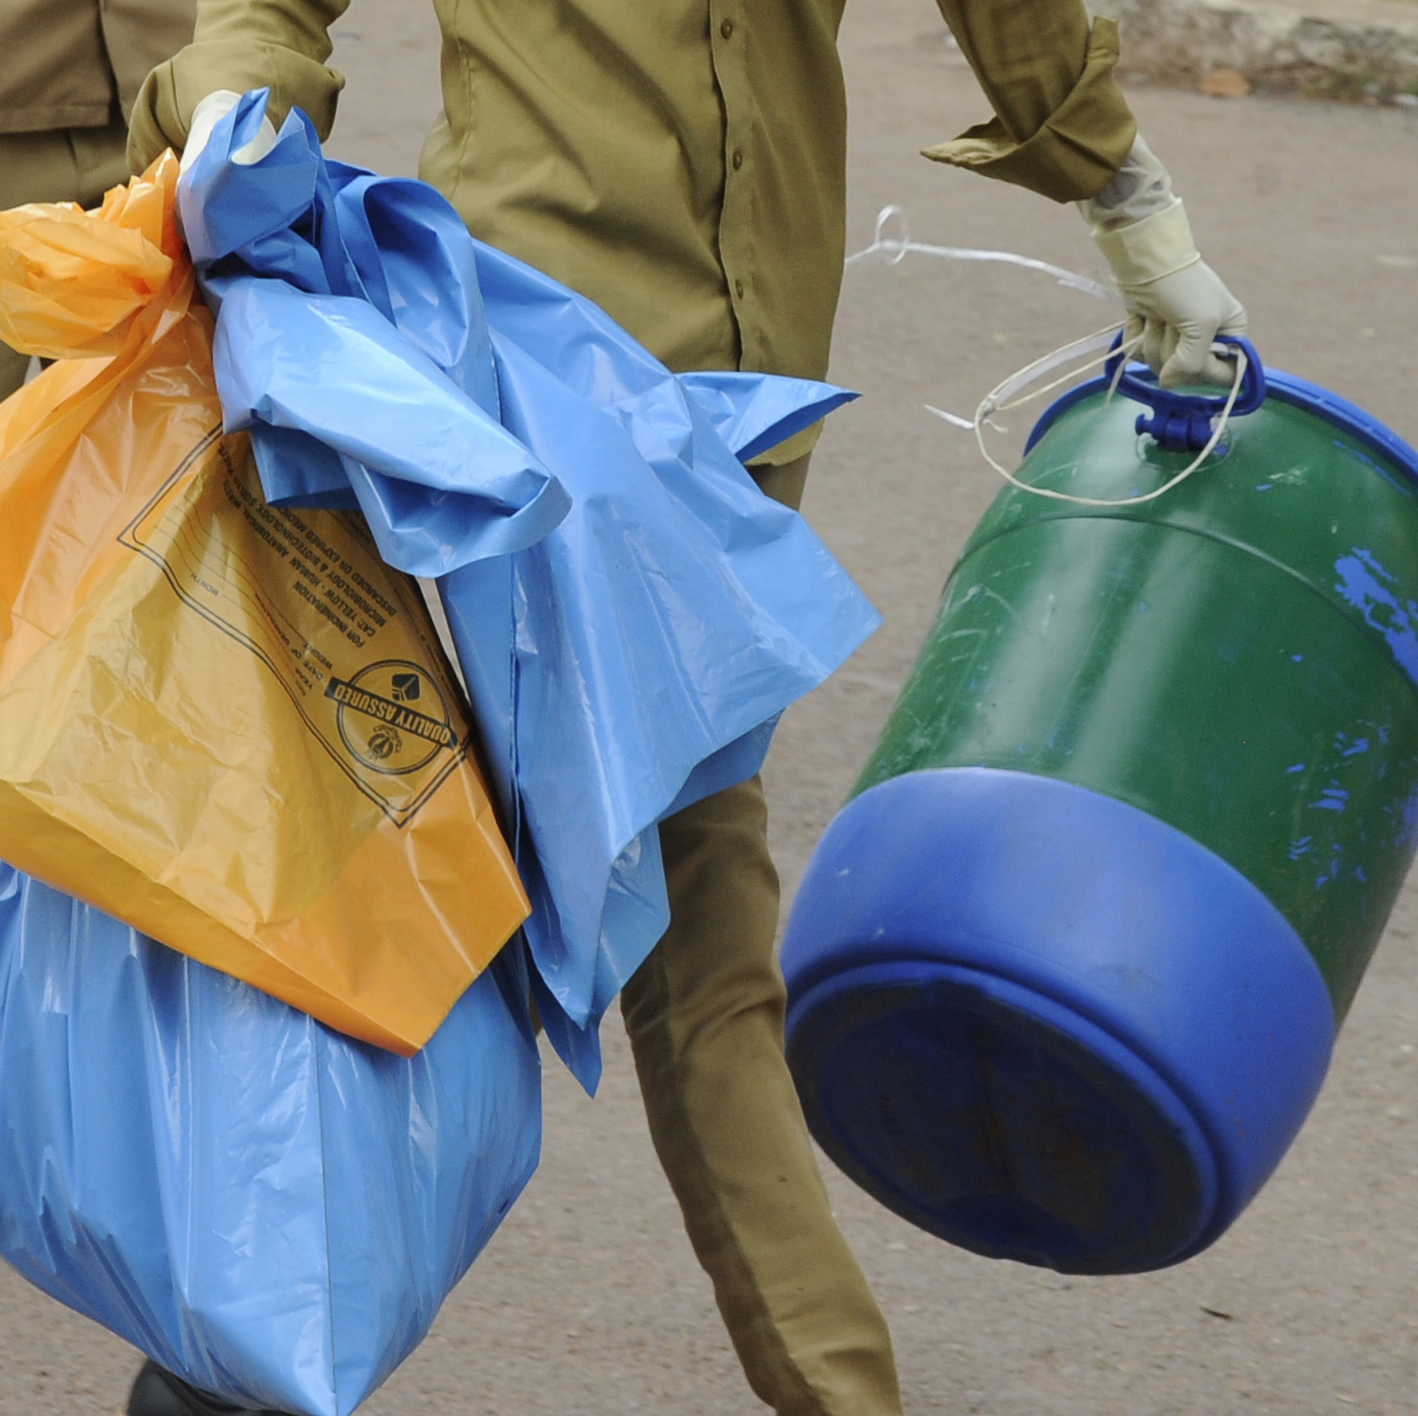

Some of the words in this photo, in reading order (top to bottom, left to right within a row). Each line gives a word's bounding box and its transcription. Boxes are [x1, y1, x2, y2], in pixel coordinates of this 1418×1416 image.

[303, 528, 340, 564] EXPIRED
[288, 555, 322, 587] HUMAN
[317, 562, 329, 574] &
[337, 559, 353, 575] OR
[291, 580, 348, 633] INCINERATION
[323, 588, 359, 621] YELLOW
[325, 569, 387, 628] MICROBIOLOGY
[349, 571, 397, 617] DISCARDED
[344, 629, 366, 649] FOR
[332, 683, 398, 721] ASSURED
[394, 707, 452, 745] QUALITY
